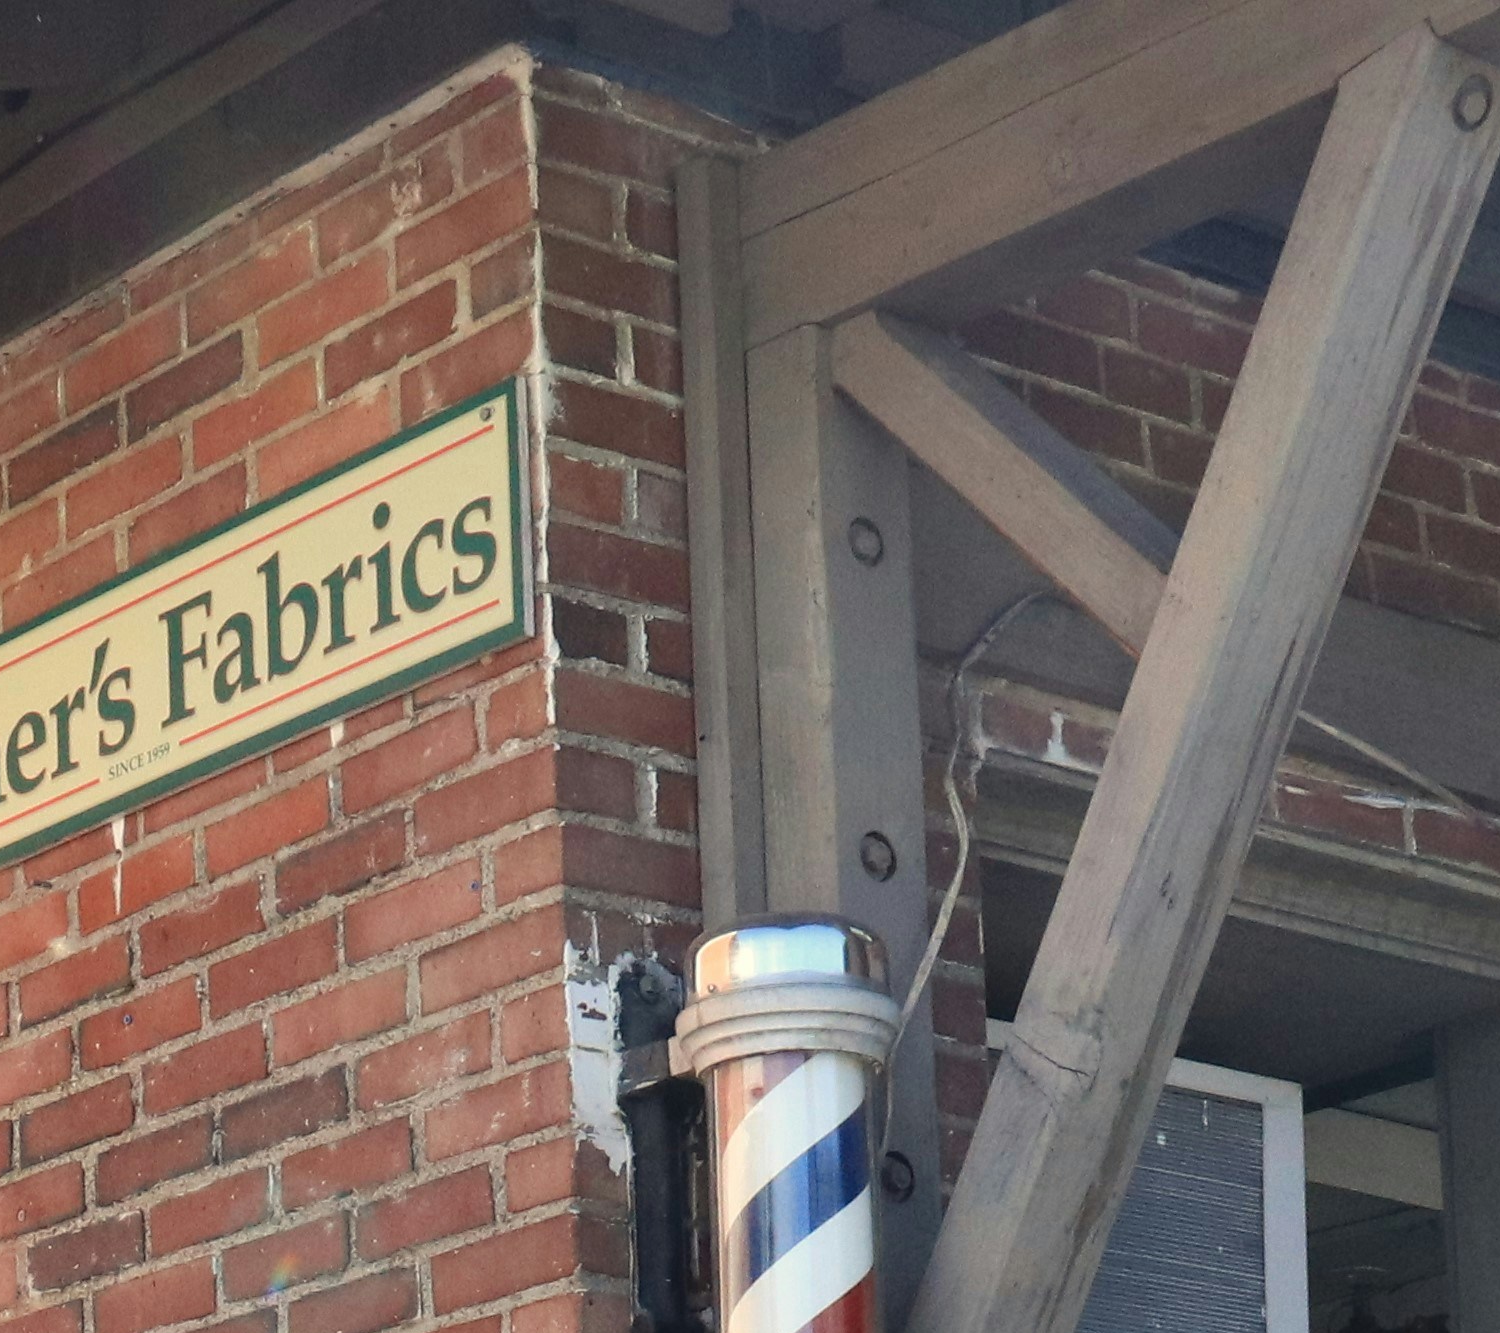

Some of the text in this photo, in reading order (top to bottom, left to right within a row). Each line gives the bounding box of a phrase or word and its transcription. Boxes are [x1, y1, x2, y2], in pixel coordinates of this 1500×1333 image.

[159, 495, 497, 730] Fabrics
[108, 741, 170, 780] SINCE 1959
